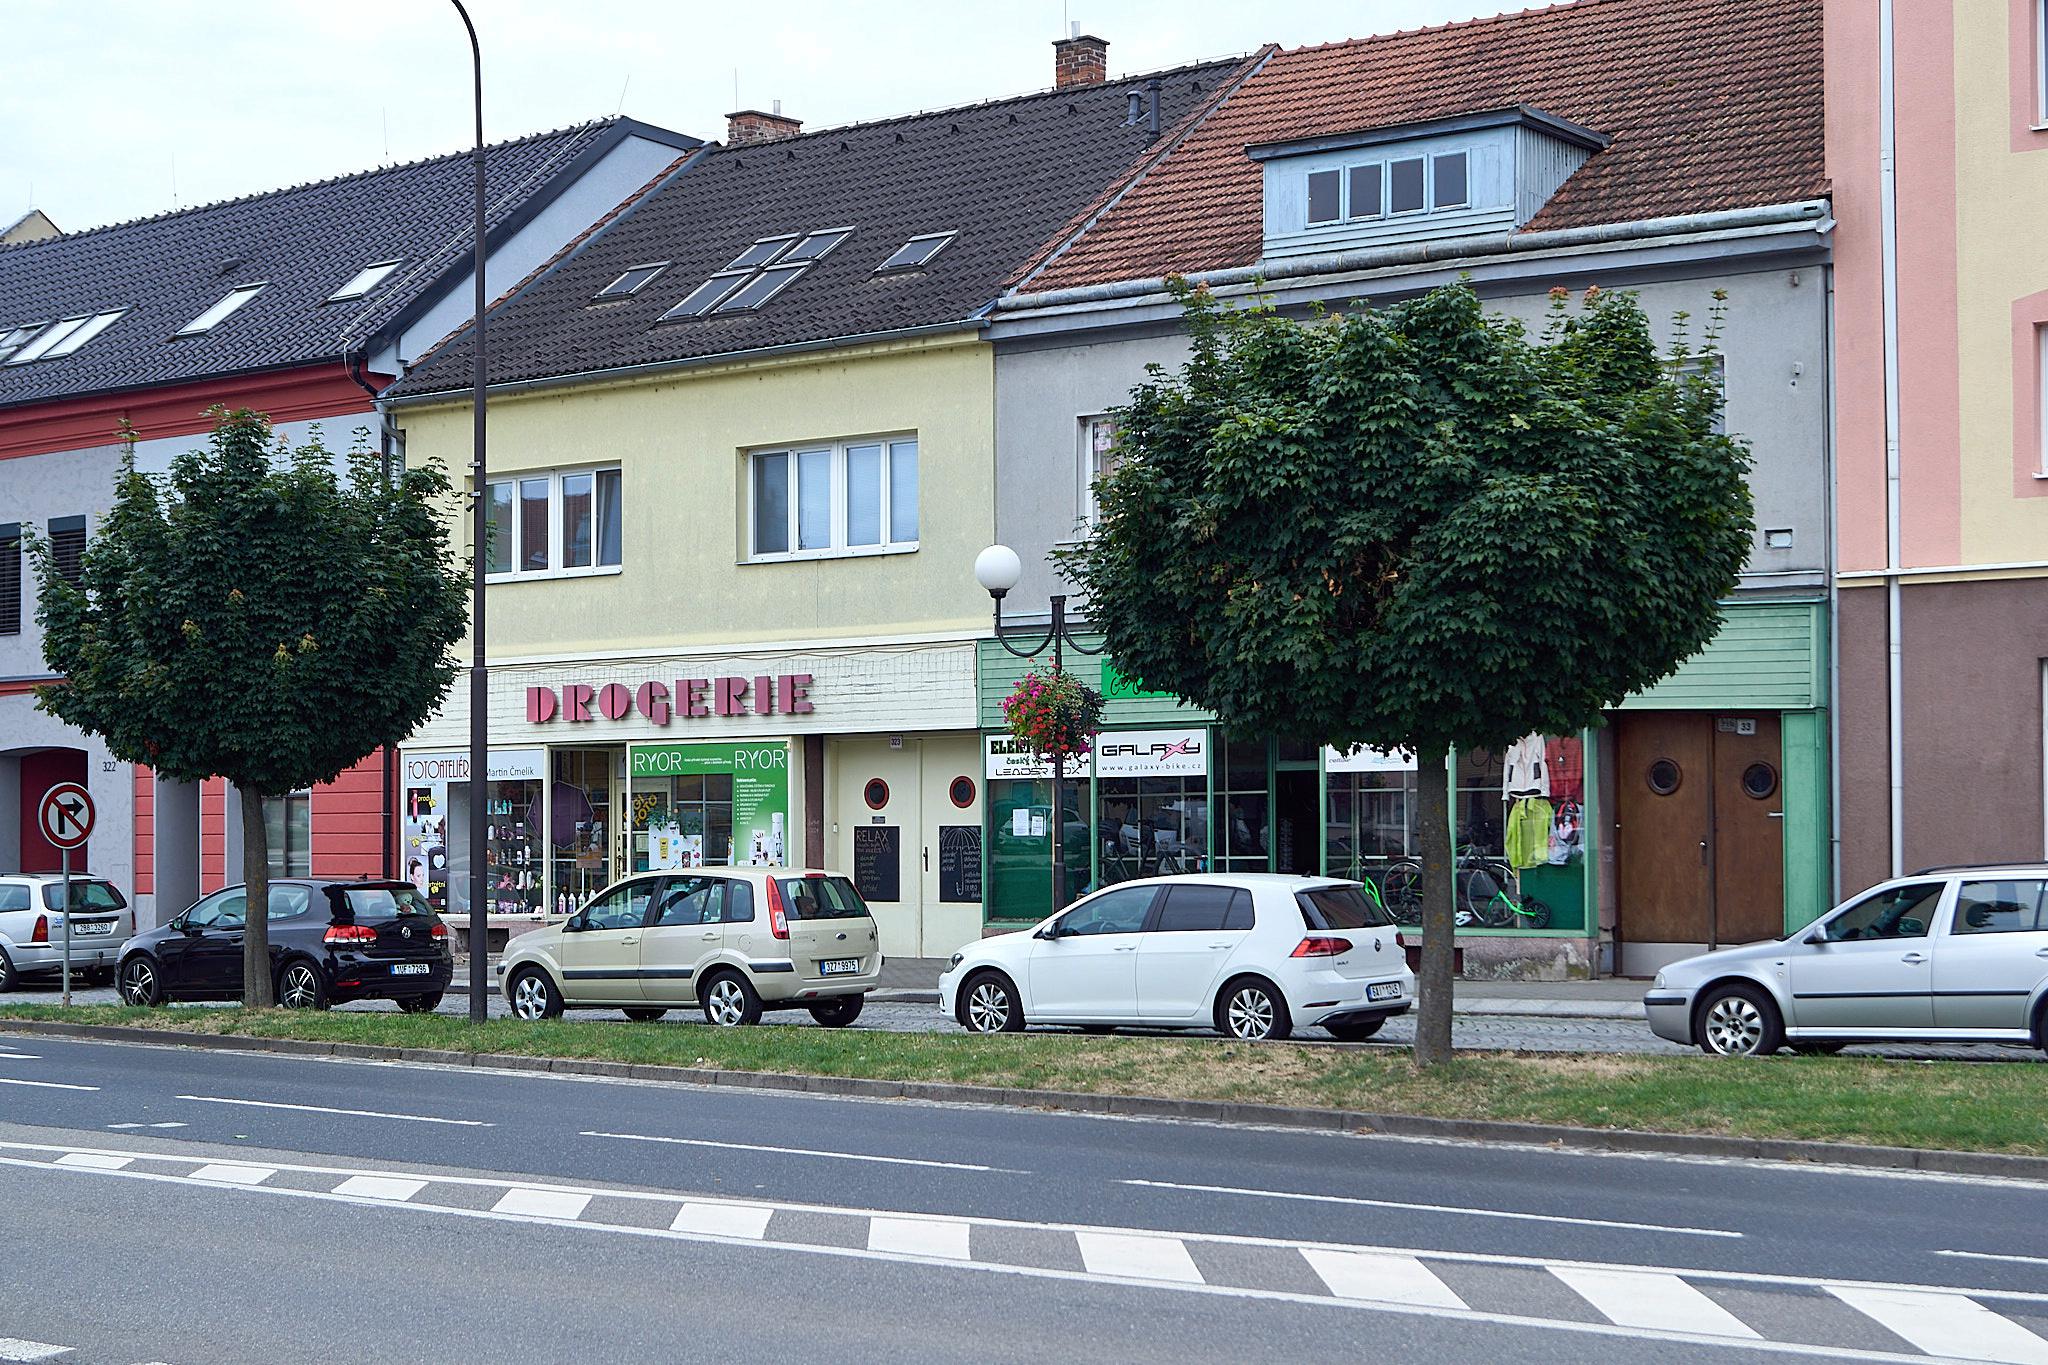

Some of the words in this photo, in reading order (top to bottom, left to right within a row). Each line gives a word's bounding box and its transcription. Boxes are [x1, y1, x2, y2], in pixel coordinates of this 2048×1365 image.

[526, 674, 814, 726] DROGERIE
[1741, 722, 1751, 731] 33
[1101, 737, 1201, 762] GALAXY
[634, 752, 682, 772] RYOR
[735, 749, 785, 769] RYOR
[102, 761, 117, 772] 322
[408, 756, 469, 779] FOTOATELIÉR
[509, 765, 535, 776] Čmelík
[1101, 763, 1201, 771] www.galaxy-bike.cz
[856, 830, 889, 842] RELAX
[826, 962, 837, 971] 3Z7
